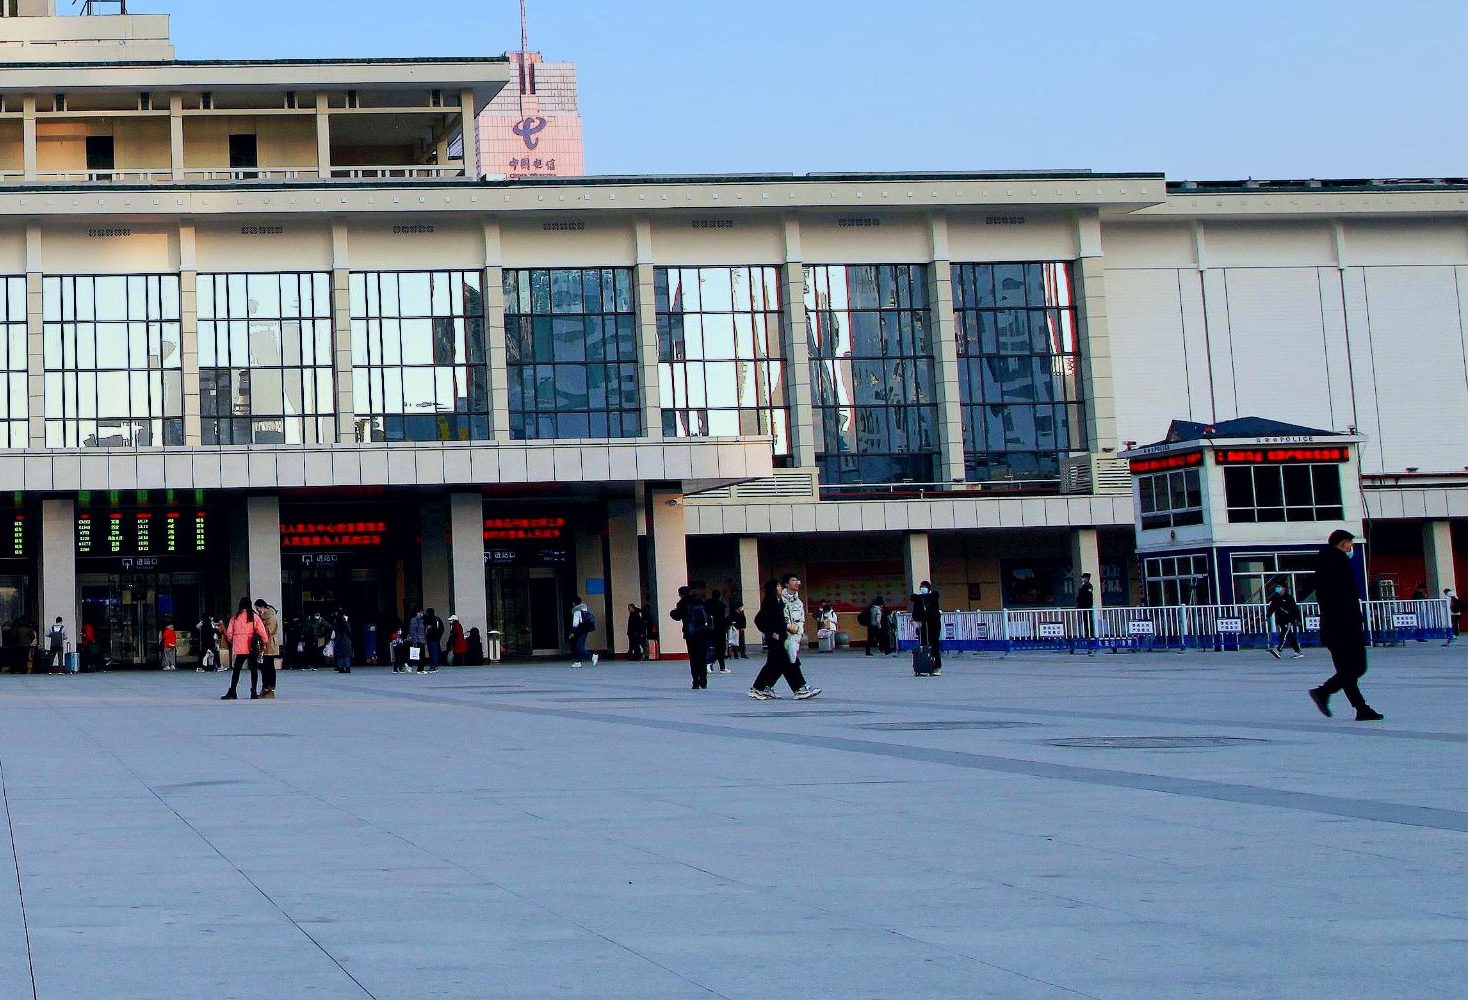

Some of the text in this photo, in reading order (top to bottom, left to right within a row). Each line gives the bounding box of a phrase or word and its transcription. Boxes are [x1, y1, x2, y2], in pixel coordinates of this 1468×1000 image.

[509, 157, 556, 171] 中国电信
[316, 554, 338, 562] 进站口
[494, 551, 516, 559] 进站口
[137, 558, 158, 566] 进站口
